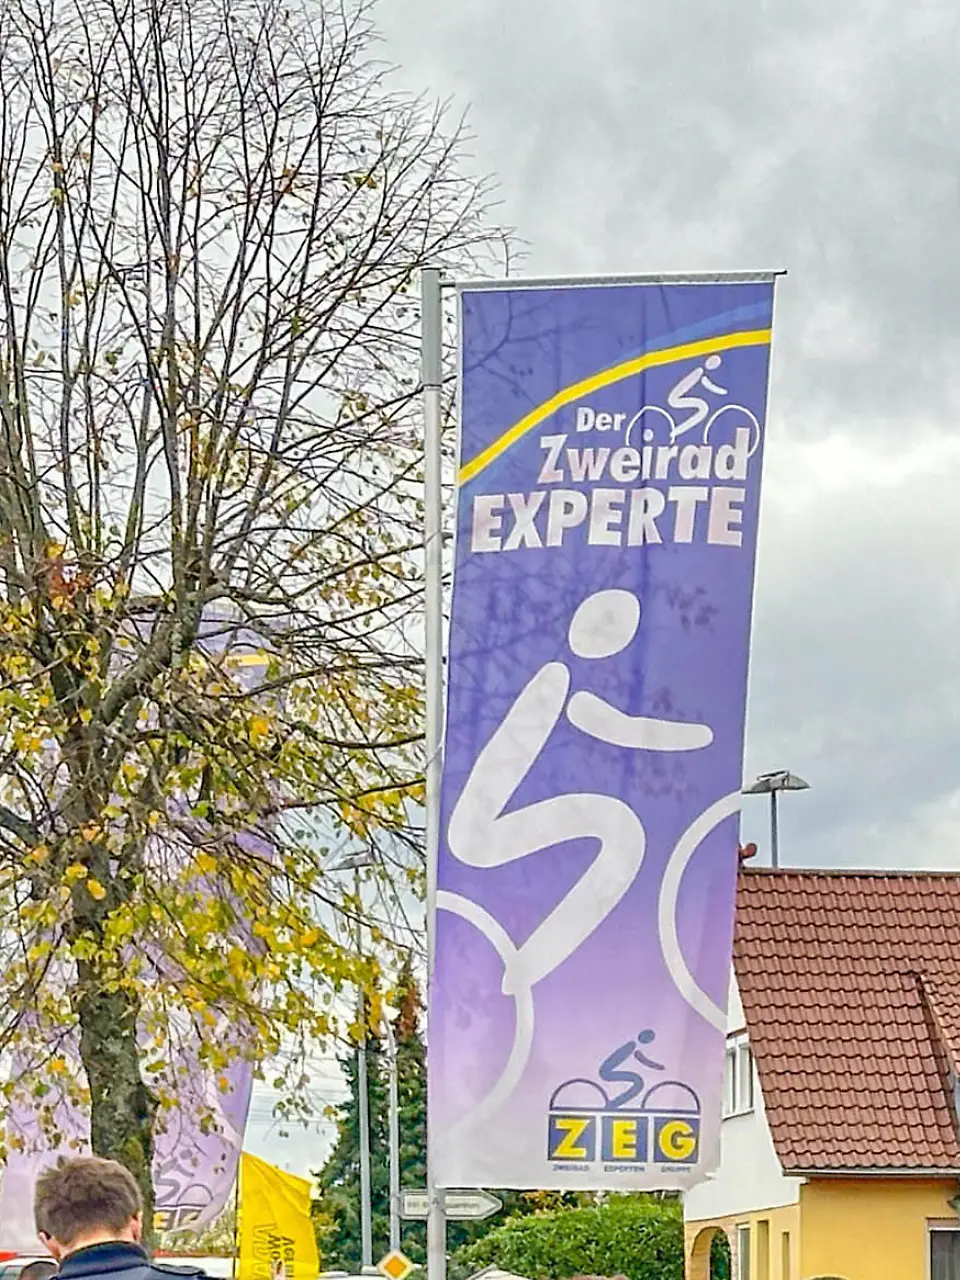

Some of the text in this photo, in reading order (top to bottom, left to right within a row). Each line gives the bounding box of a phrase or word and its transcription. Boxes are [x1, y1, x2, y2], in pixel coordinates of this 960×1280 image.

[576, 407, 627, 432] Der
[538, 427, 749, 484] Zweirad
[471, 487, 746, 553] EXPERTE
[551, 1117, 696, 1161] ZEG
